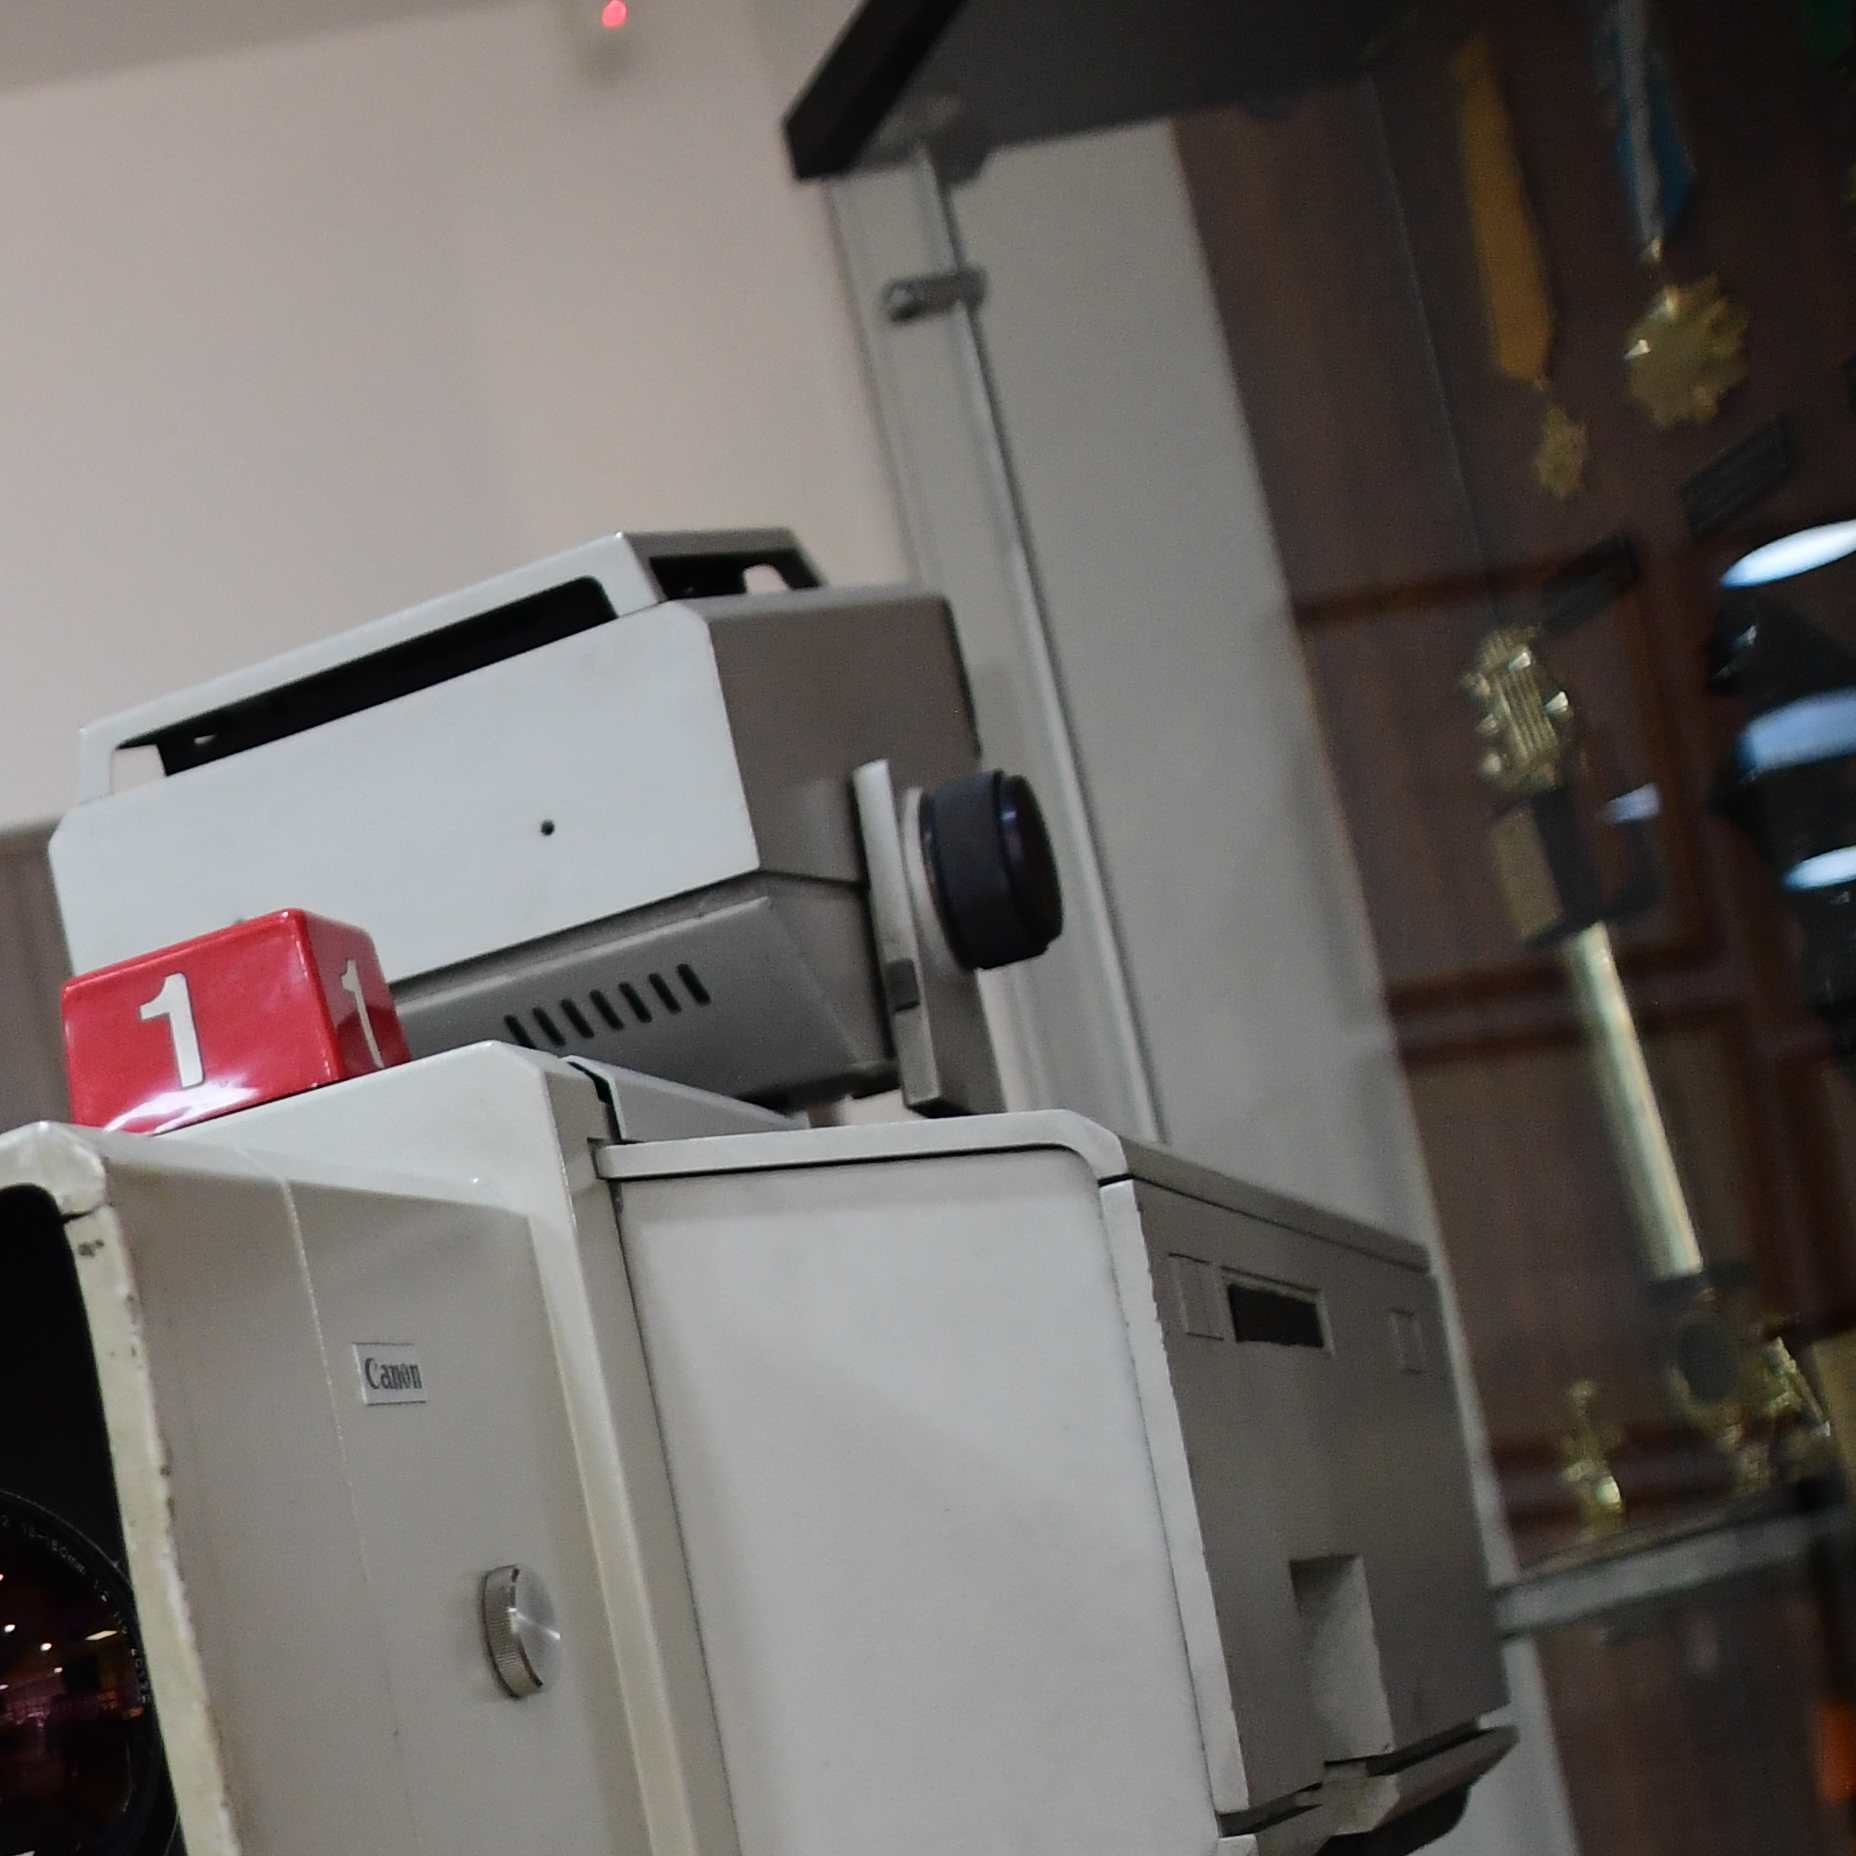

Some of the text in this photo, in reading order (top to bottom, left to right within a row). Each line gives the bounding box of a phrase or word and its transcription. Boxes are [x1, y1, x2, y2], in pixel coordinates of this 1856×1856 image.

[140, 972, 205, 1088] 1
[341, 958, 386, 1069] 1
[365, 1357, 423, 1390] Canon
